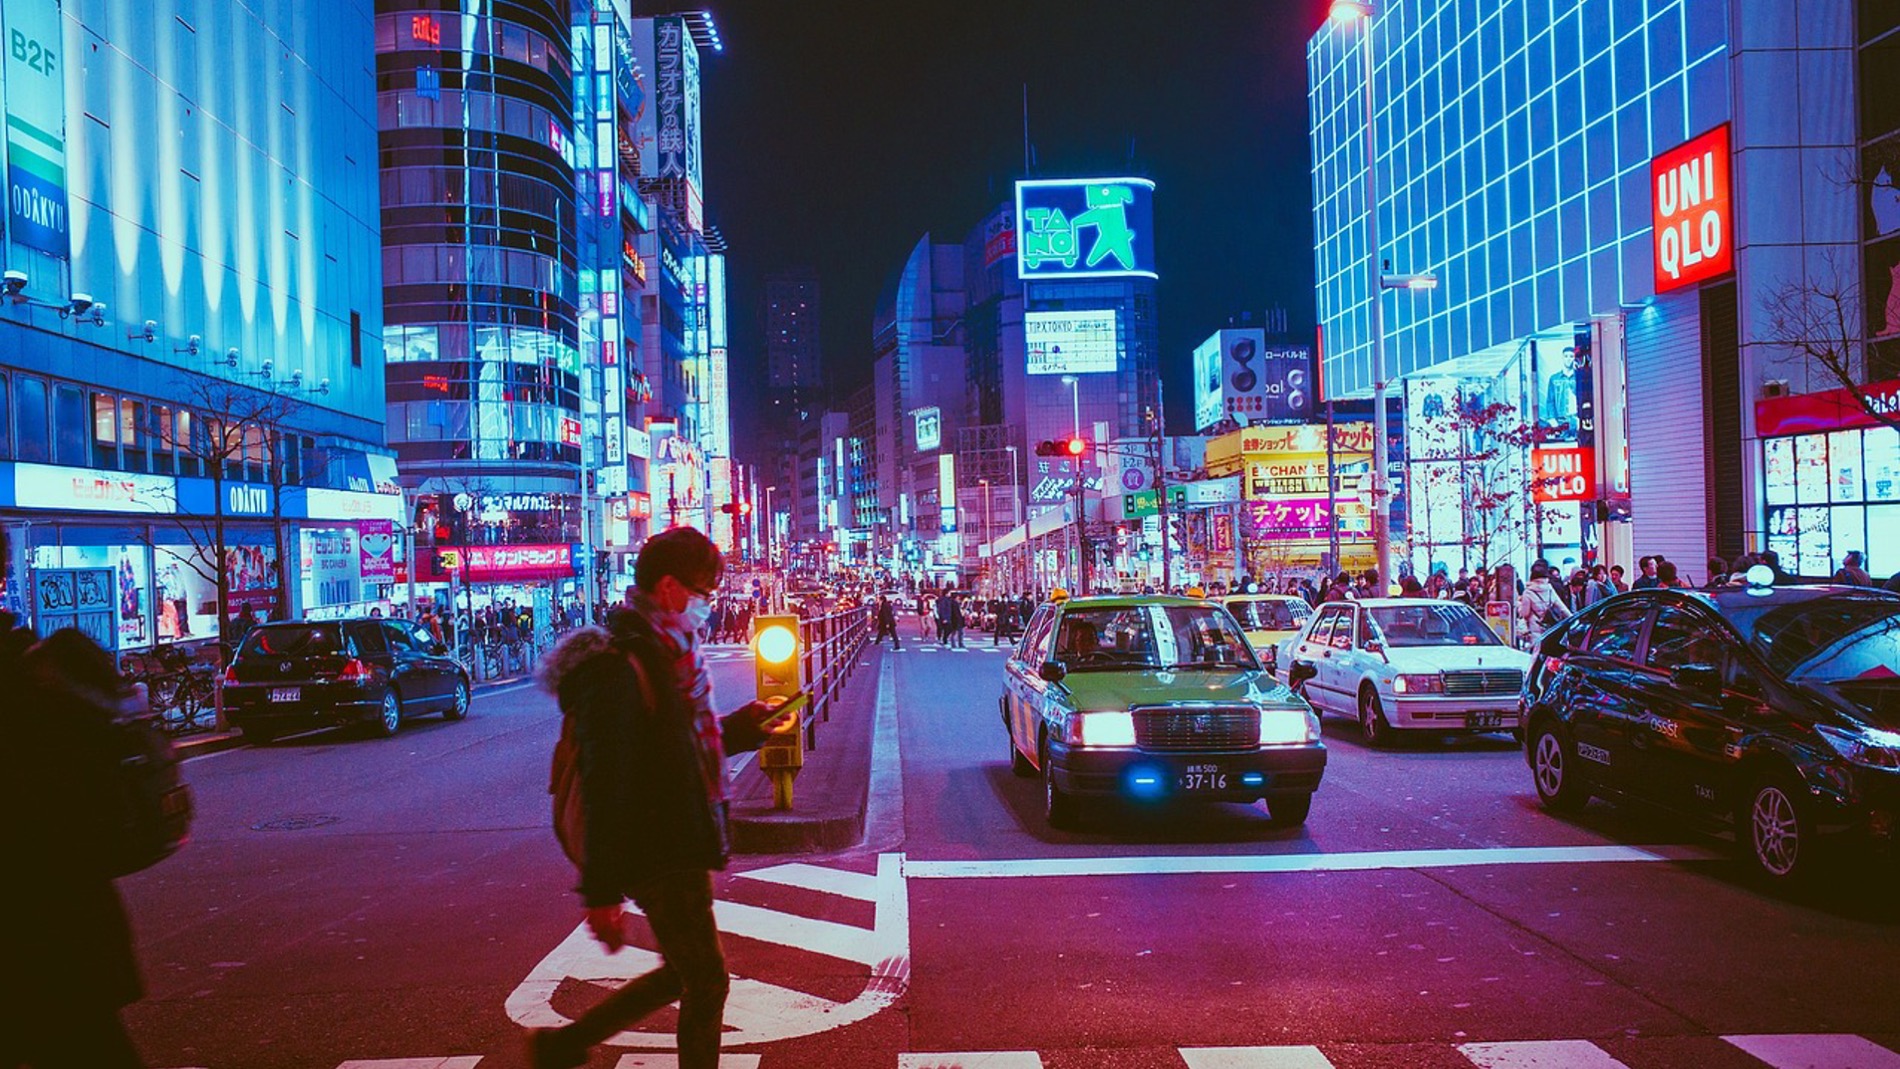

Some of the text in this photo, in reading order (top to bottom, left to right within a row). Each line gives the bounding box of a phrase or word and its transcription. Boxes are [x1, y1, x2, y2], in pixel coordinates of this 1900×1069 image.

[11, 28, 56, 77] B2F
[658, 22, 685, 179] カラオケの鉄人
[1658, 151, 1714, 217] UNI
[1025, 208, 1072, 231] TA
[1027, 232, 1074, 255] NO
[1660, 210, 1721, 279] QLO
[1543, 454, 1582, 473] UNI
[1545, 475, 1586, 499] QLO
[1253, 503, 1330, 523] チケット
[494, 549, 556, 565] サンドラッグ
[1203, 764, 1218, 773] 500
[1185, 774, 1227, 790] 37-16
[1695, 784, 1715, 801] TAXI
